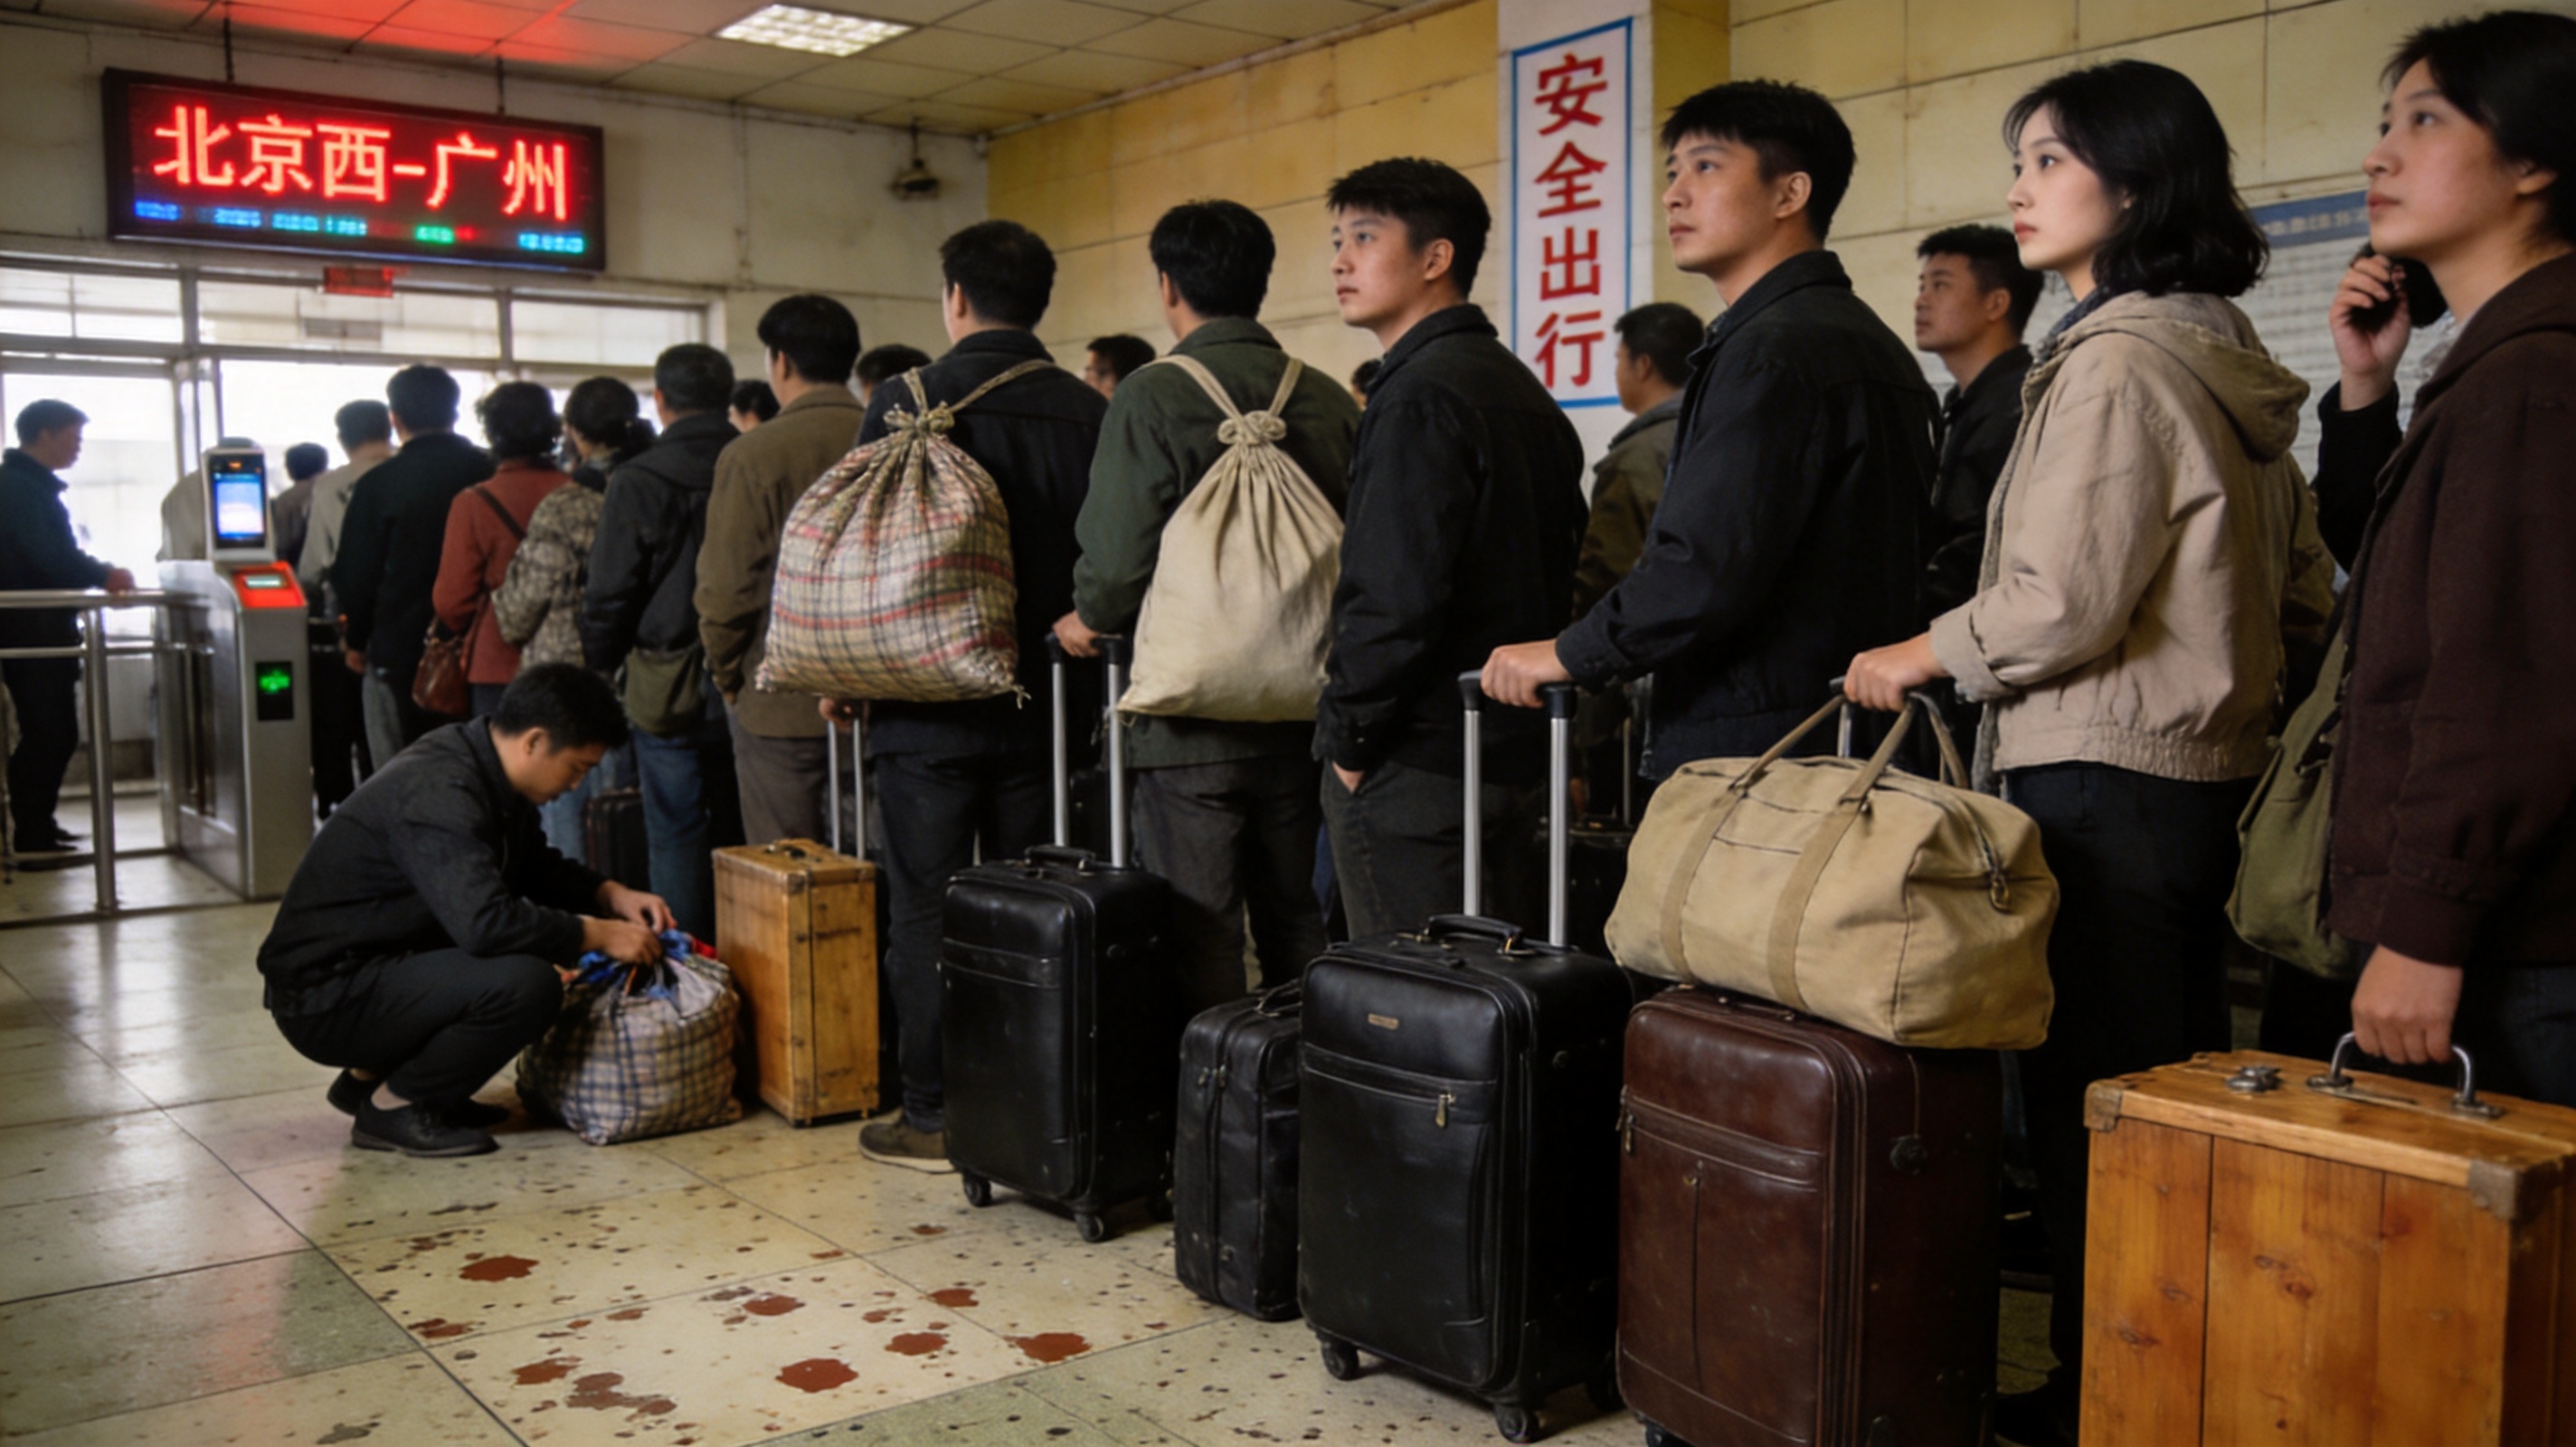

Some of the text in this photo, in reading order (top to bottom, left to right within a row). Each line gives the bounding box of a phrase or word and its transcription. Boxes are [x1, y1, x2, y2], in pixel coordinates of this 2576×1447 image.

[154, 105, 567, 220] 北京西-广州
[1533, 52, 1608, 389] 安全出行
